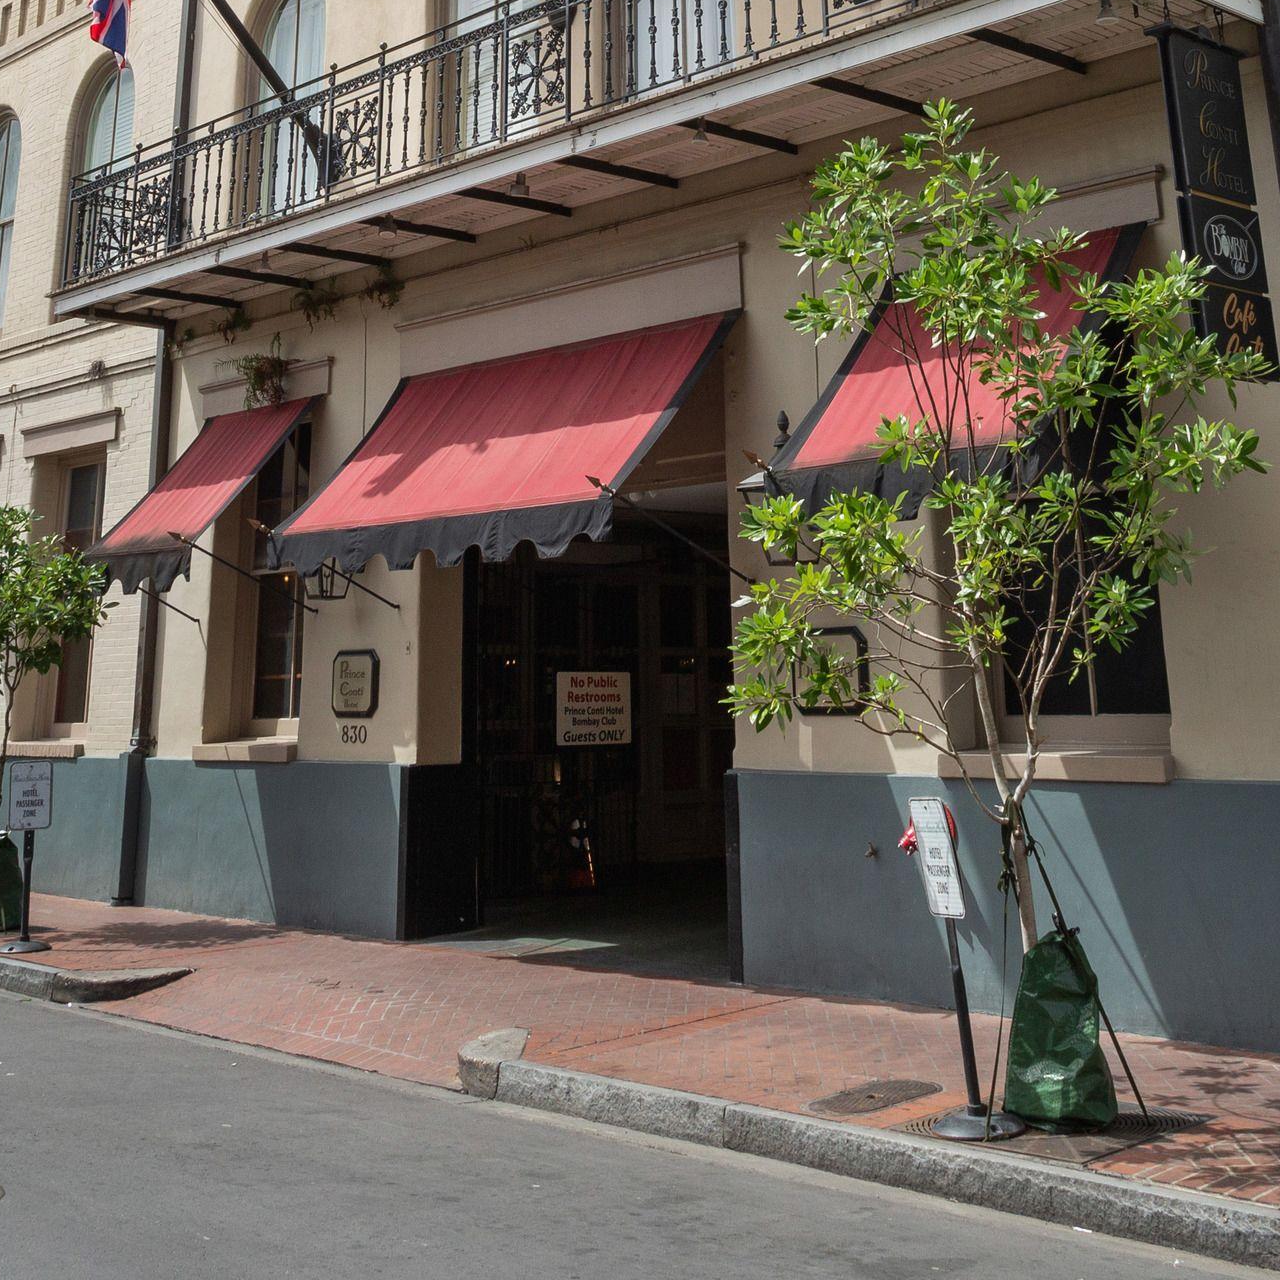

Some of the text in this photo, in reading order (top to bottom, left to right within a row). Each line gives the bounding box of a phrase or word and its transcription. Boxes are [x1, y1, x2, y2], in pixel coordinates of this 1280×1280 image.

[1210, 224, 1249, 263] BOMBAY
[1223, 293, 1257, 334] Café
[340, 661, 365, 679] Prince
[570, 676, 618, 688] No Public
[340, 682, 363, 696] Conti
[568, 691, 622, 703] Restrooms
[564, 706, 624, 715] Prince Conti Hotel
[572, 717, 616, 728] Bombay Club
[341, 725, 367, 744] 830
[563, 730, 625, 742] Guests ONLY
[23, 789, 38, 797] HOTEL
[16, 799, 44, 808] PASSENGER
[23, 809, 36, 818] ZONE
